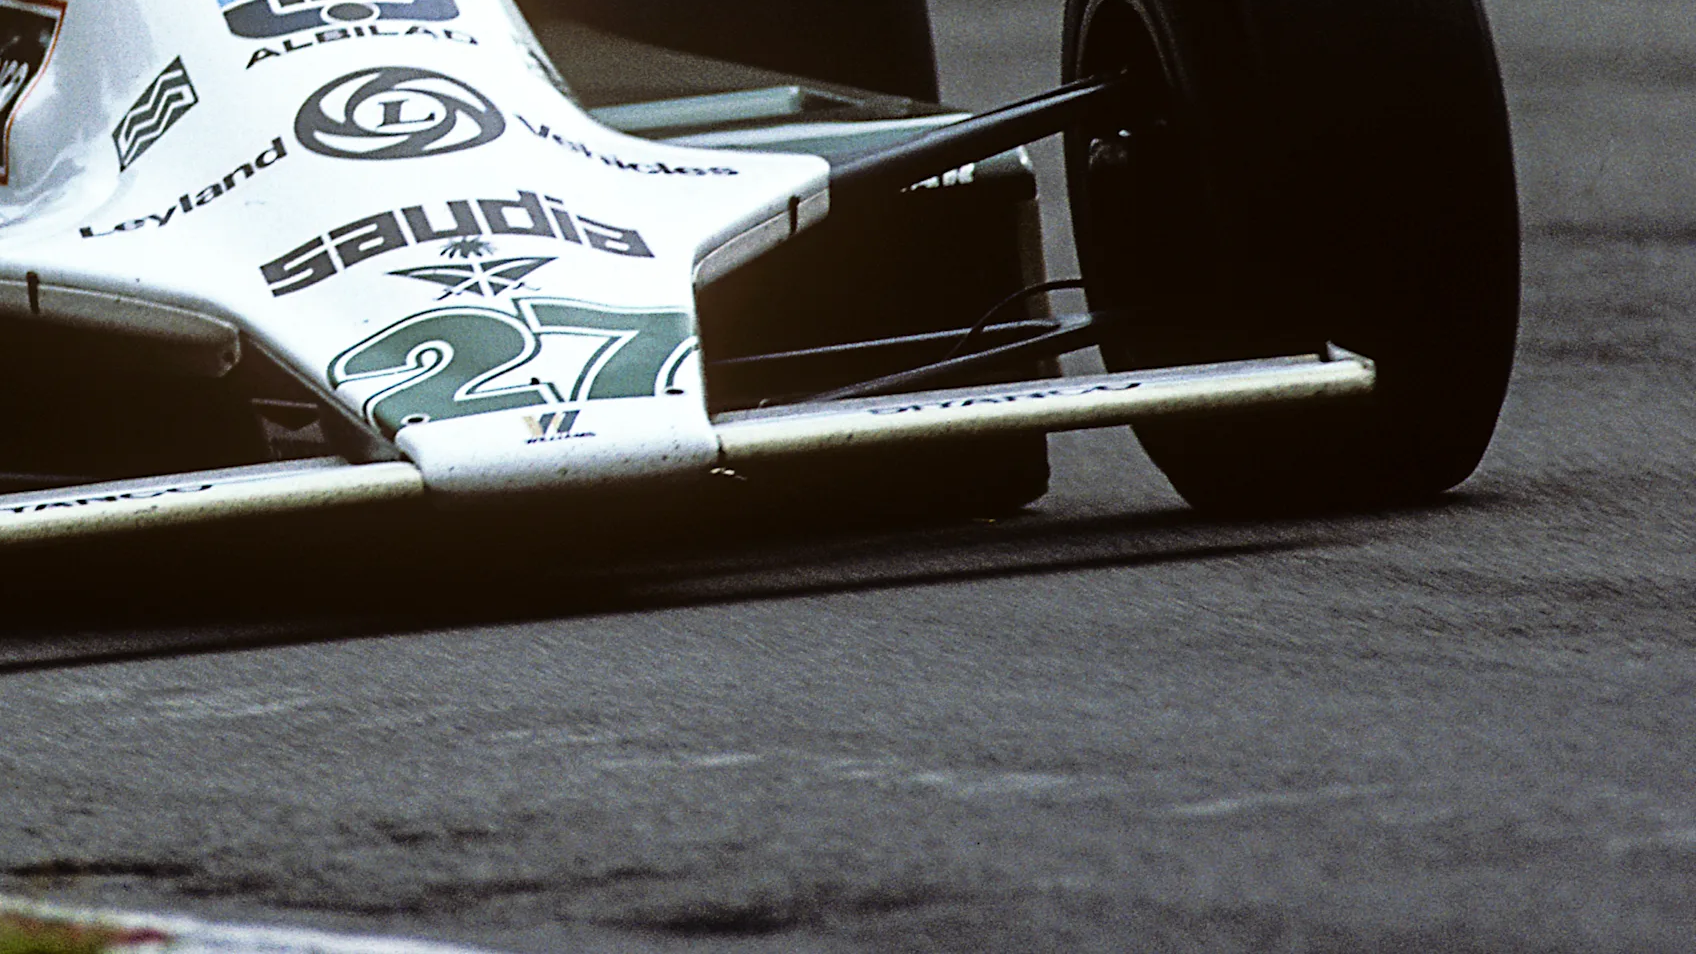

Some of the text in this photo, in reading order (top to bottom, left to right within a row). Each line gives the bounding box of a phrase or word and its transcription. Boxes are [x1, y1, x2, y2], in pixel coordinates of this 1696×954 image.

[245, 24, 479, 70] ALBILAD
[377, 97, 437, 129] L
[78, 112, 740, 240] Leyland Vehicles
[258, 189, 656, 298] saudia
[327, 296, 702, 440] 27
